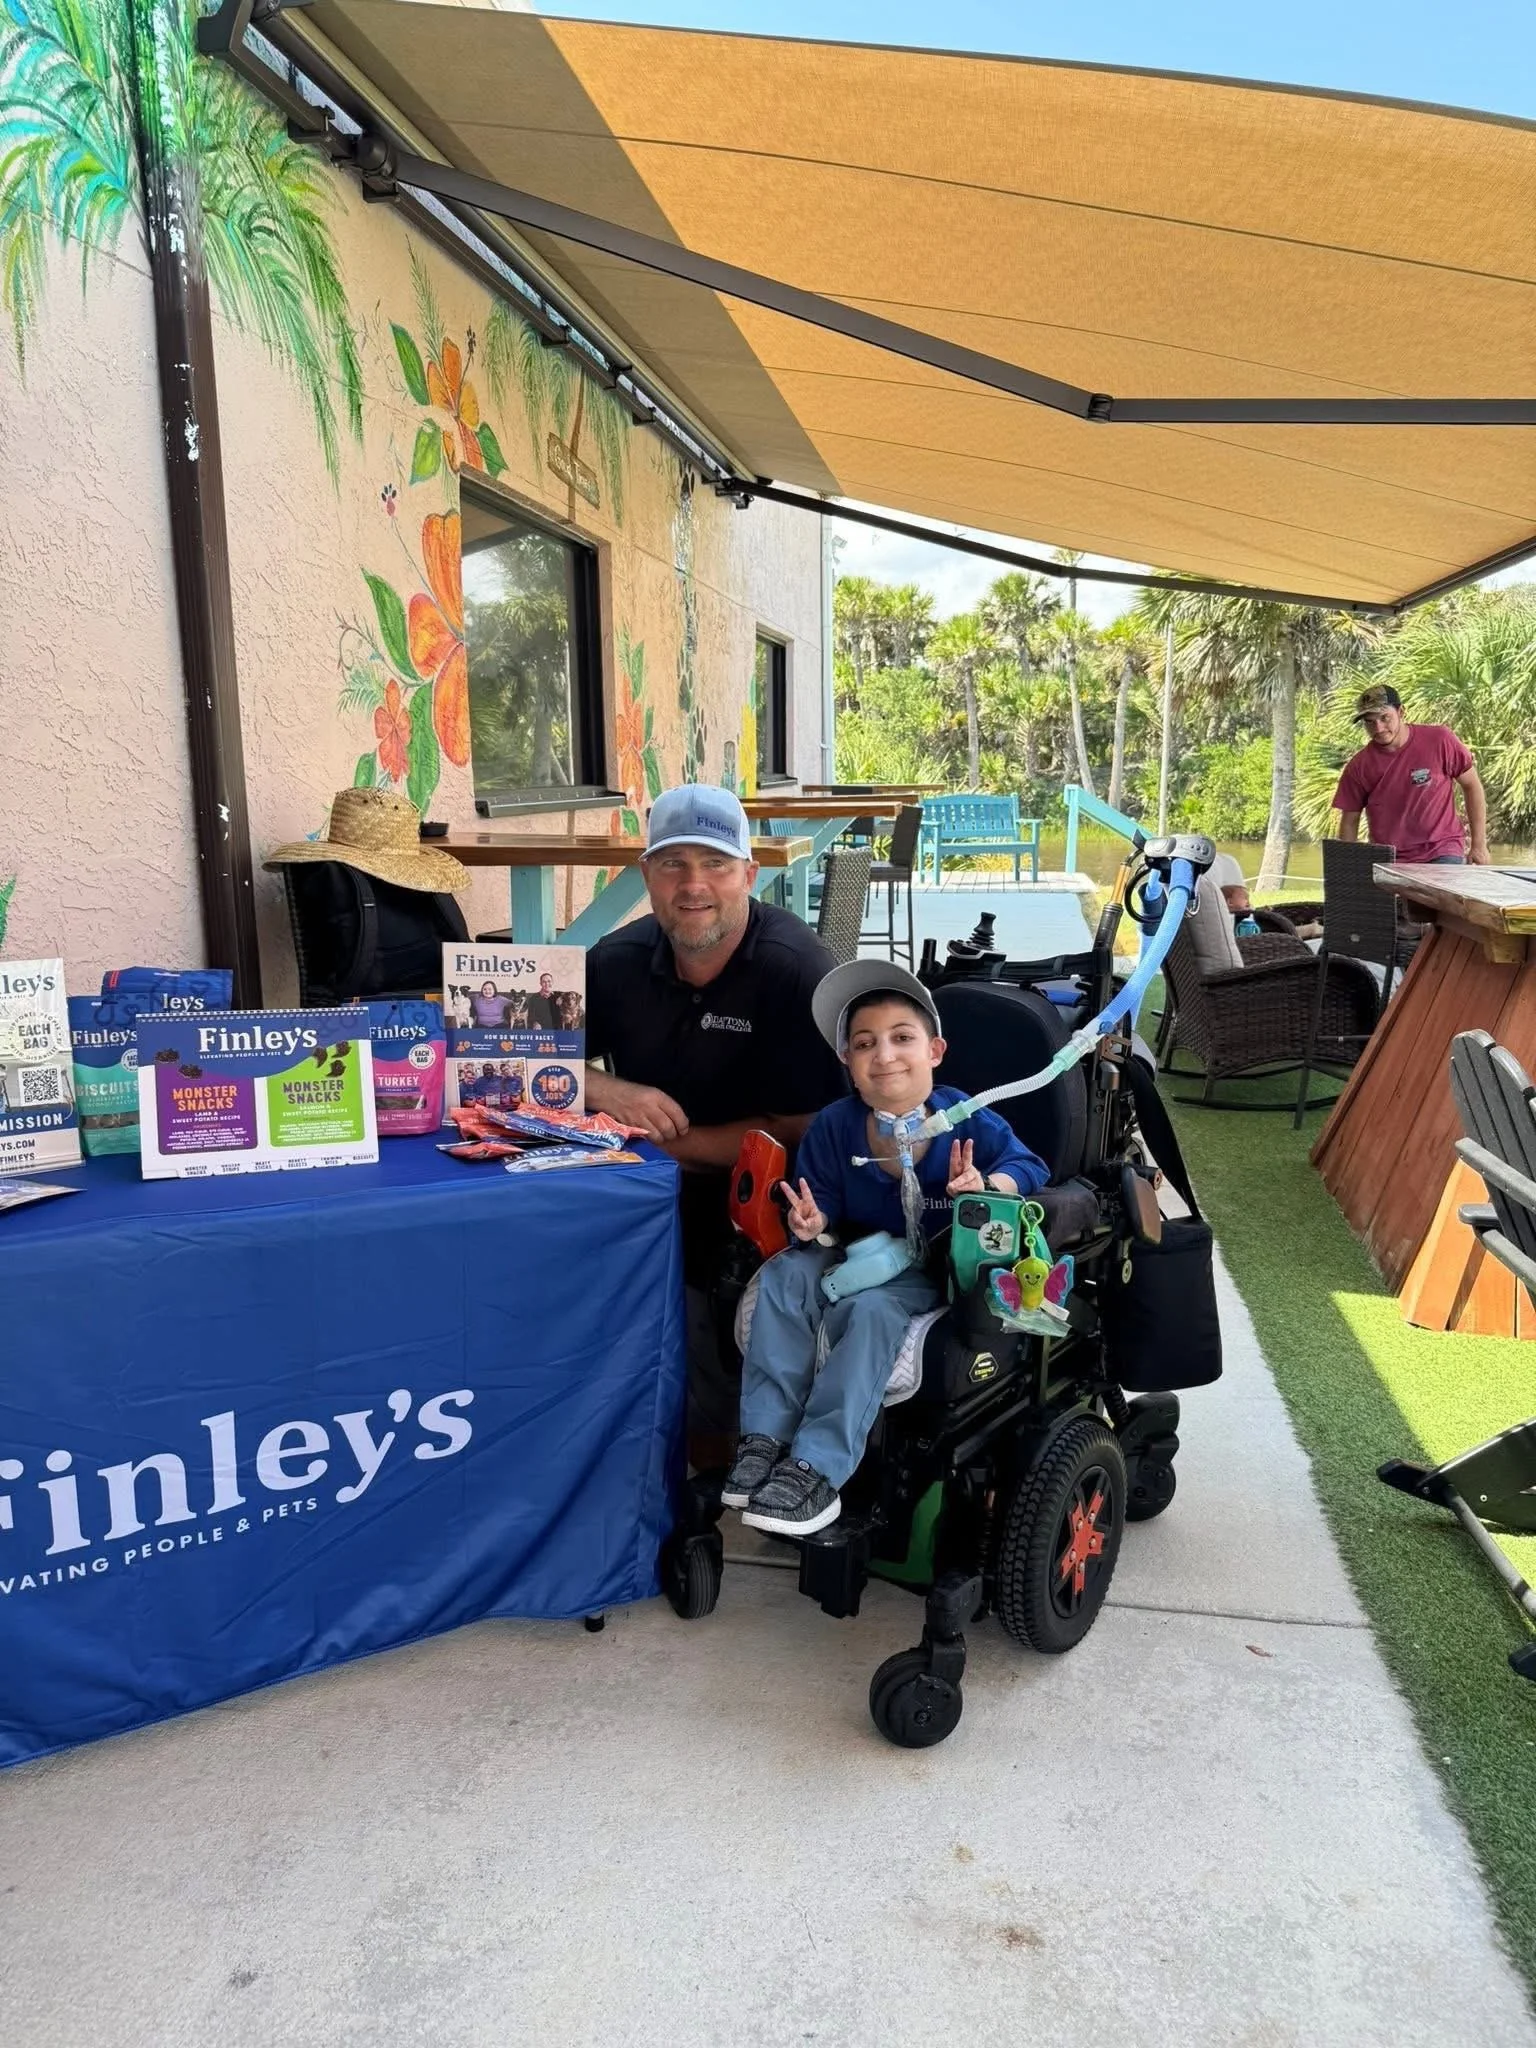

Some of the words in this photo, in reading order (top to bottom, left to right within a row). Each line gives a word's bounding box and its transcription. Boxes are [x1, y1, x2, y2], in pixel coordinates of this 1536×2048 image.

[455, 954, 537, 978] Finley's
[0, 974, 56, 997] ley's
[18, 1023, 51, 1036] EACH
[72, 1029, 138, 1046] Finley's
[369, 1025, 427, 1041] Finley's
[23, 1036, 49, 1050] BAG
[198, 1025, 318, 1056] Finley's
[76, 1080, 138, 1097] BISCUITS
[283, 1079, 345, 1093] MONSTER
[377, 1076, 420, 1087] TURKEY
[172, 1085, 238, 1100] MONSTER
[288, 1091, 341, 1105] SNACKS
[178, 1097, 234, 1112] SNACKS
[0, 1112, 63, 1131] MISSION
[0, 1558, 109, 1594] VATING
[125, 1527, 223, 1565] PEOPLE
[236, 1518, 250, 1533] &
[263, 1497, 318, 1523] PETS
